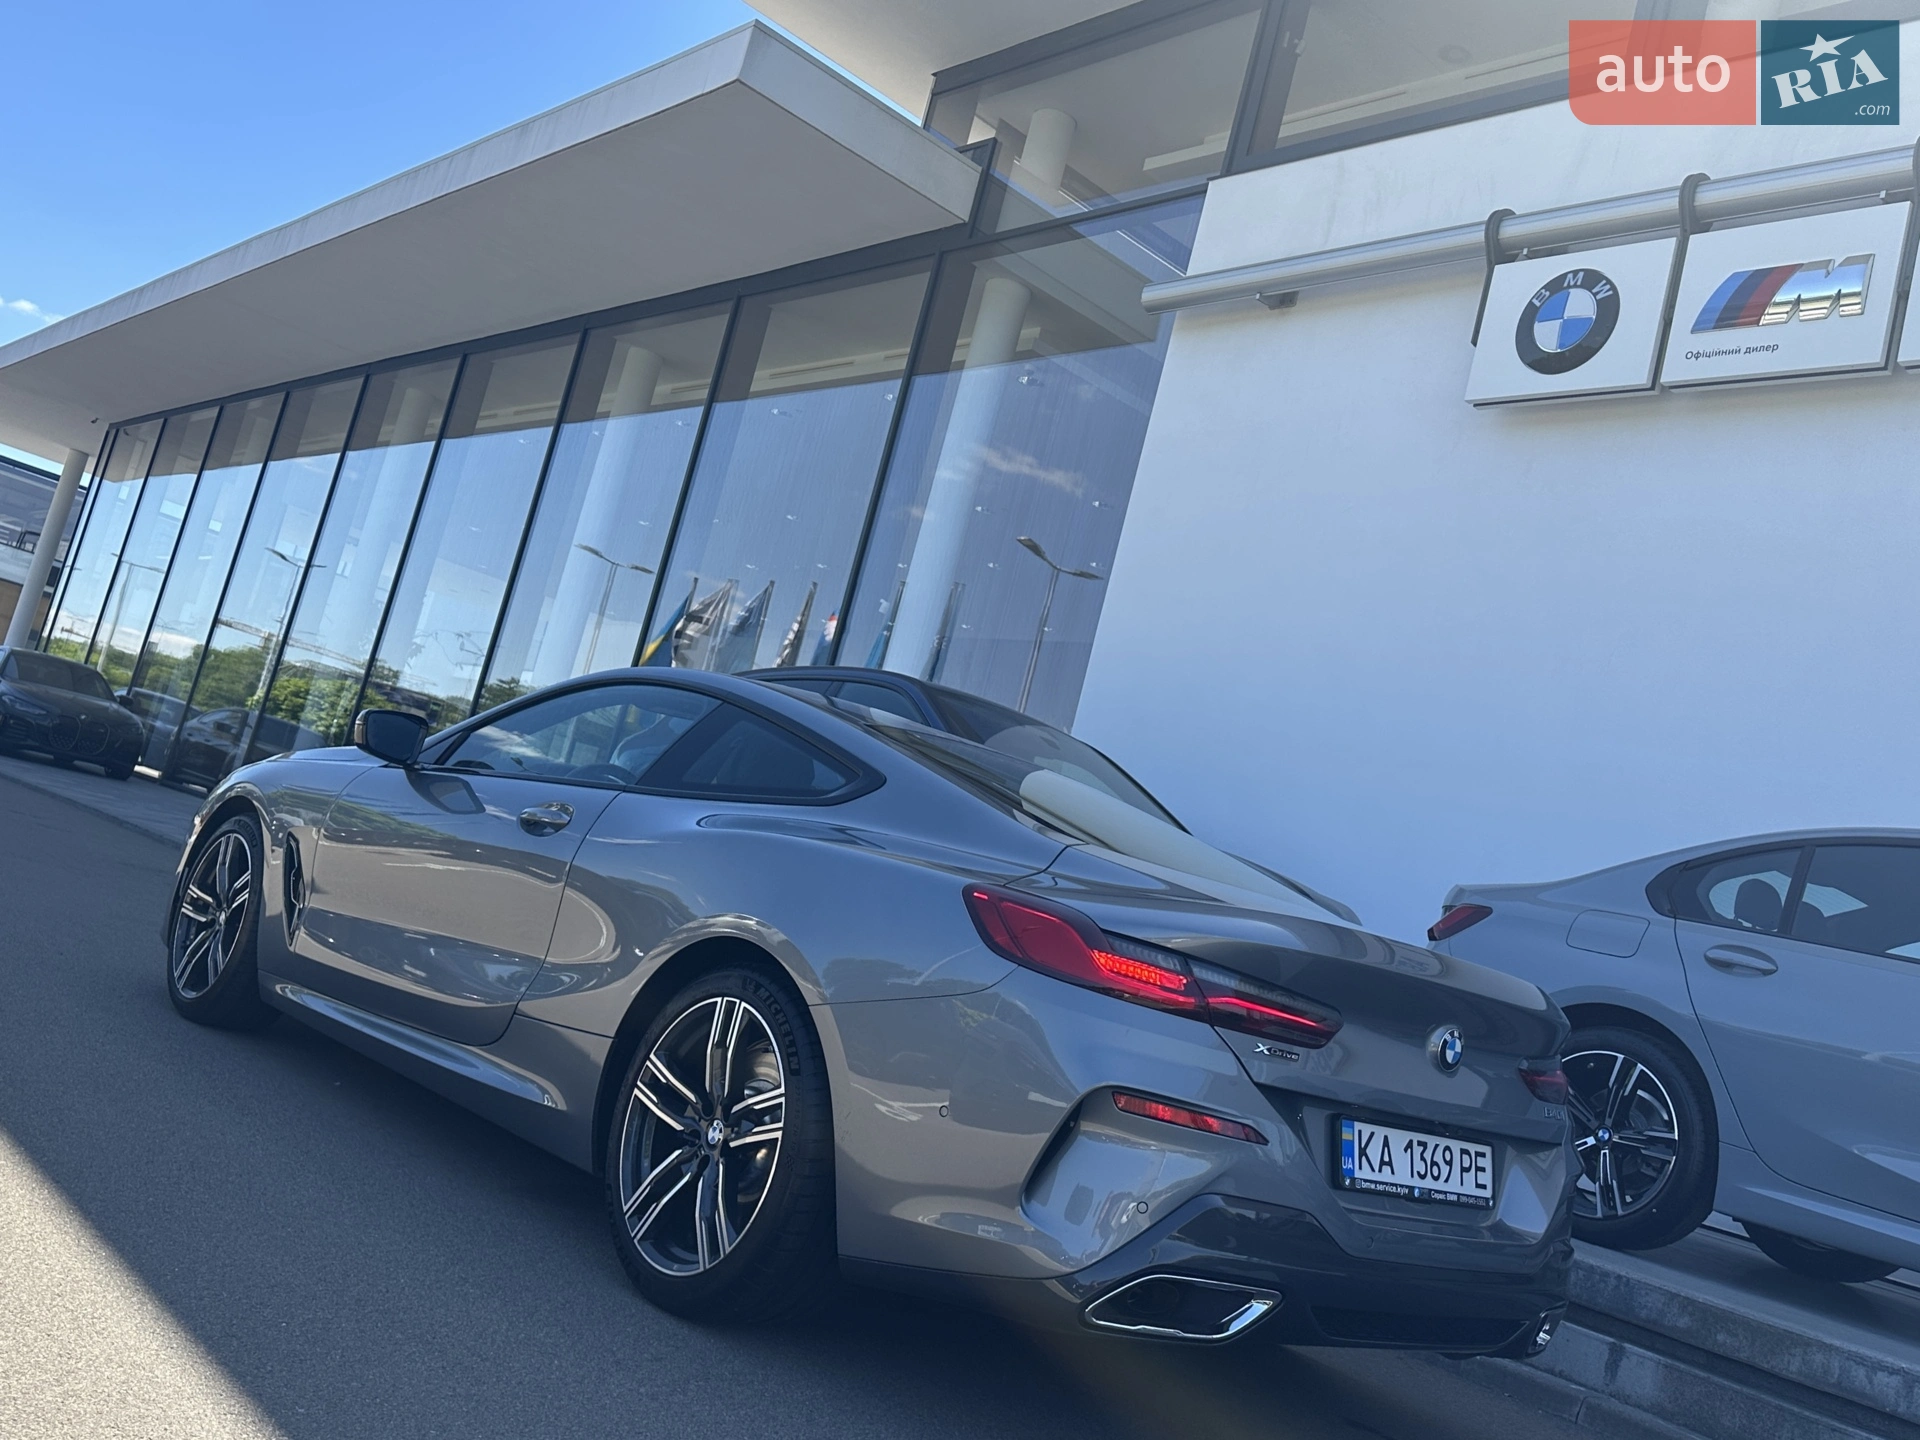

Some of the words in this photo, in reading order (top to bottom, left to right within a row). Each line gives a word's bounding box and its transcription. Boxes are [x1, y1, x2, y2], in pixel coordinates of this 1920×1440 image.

[1531, 271, 1614, 307] BMW
[1685, 346, 1741, 361] Офіційний
[1744, 343, 1779, 355] дилер
[756, 986, 799, 1071] MICHELIN
[1341, 1156, 1354, 1171] UA
[1357, 1129, 1395, 1176] KA
[1403, 1138, 1454, 1184] 1369
[1459, 1147, 1488, 1191] PE
